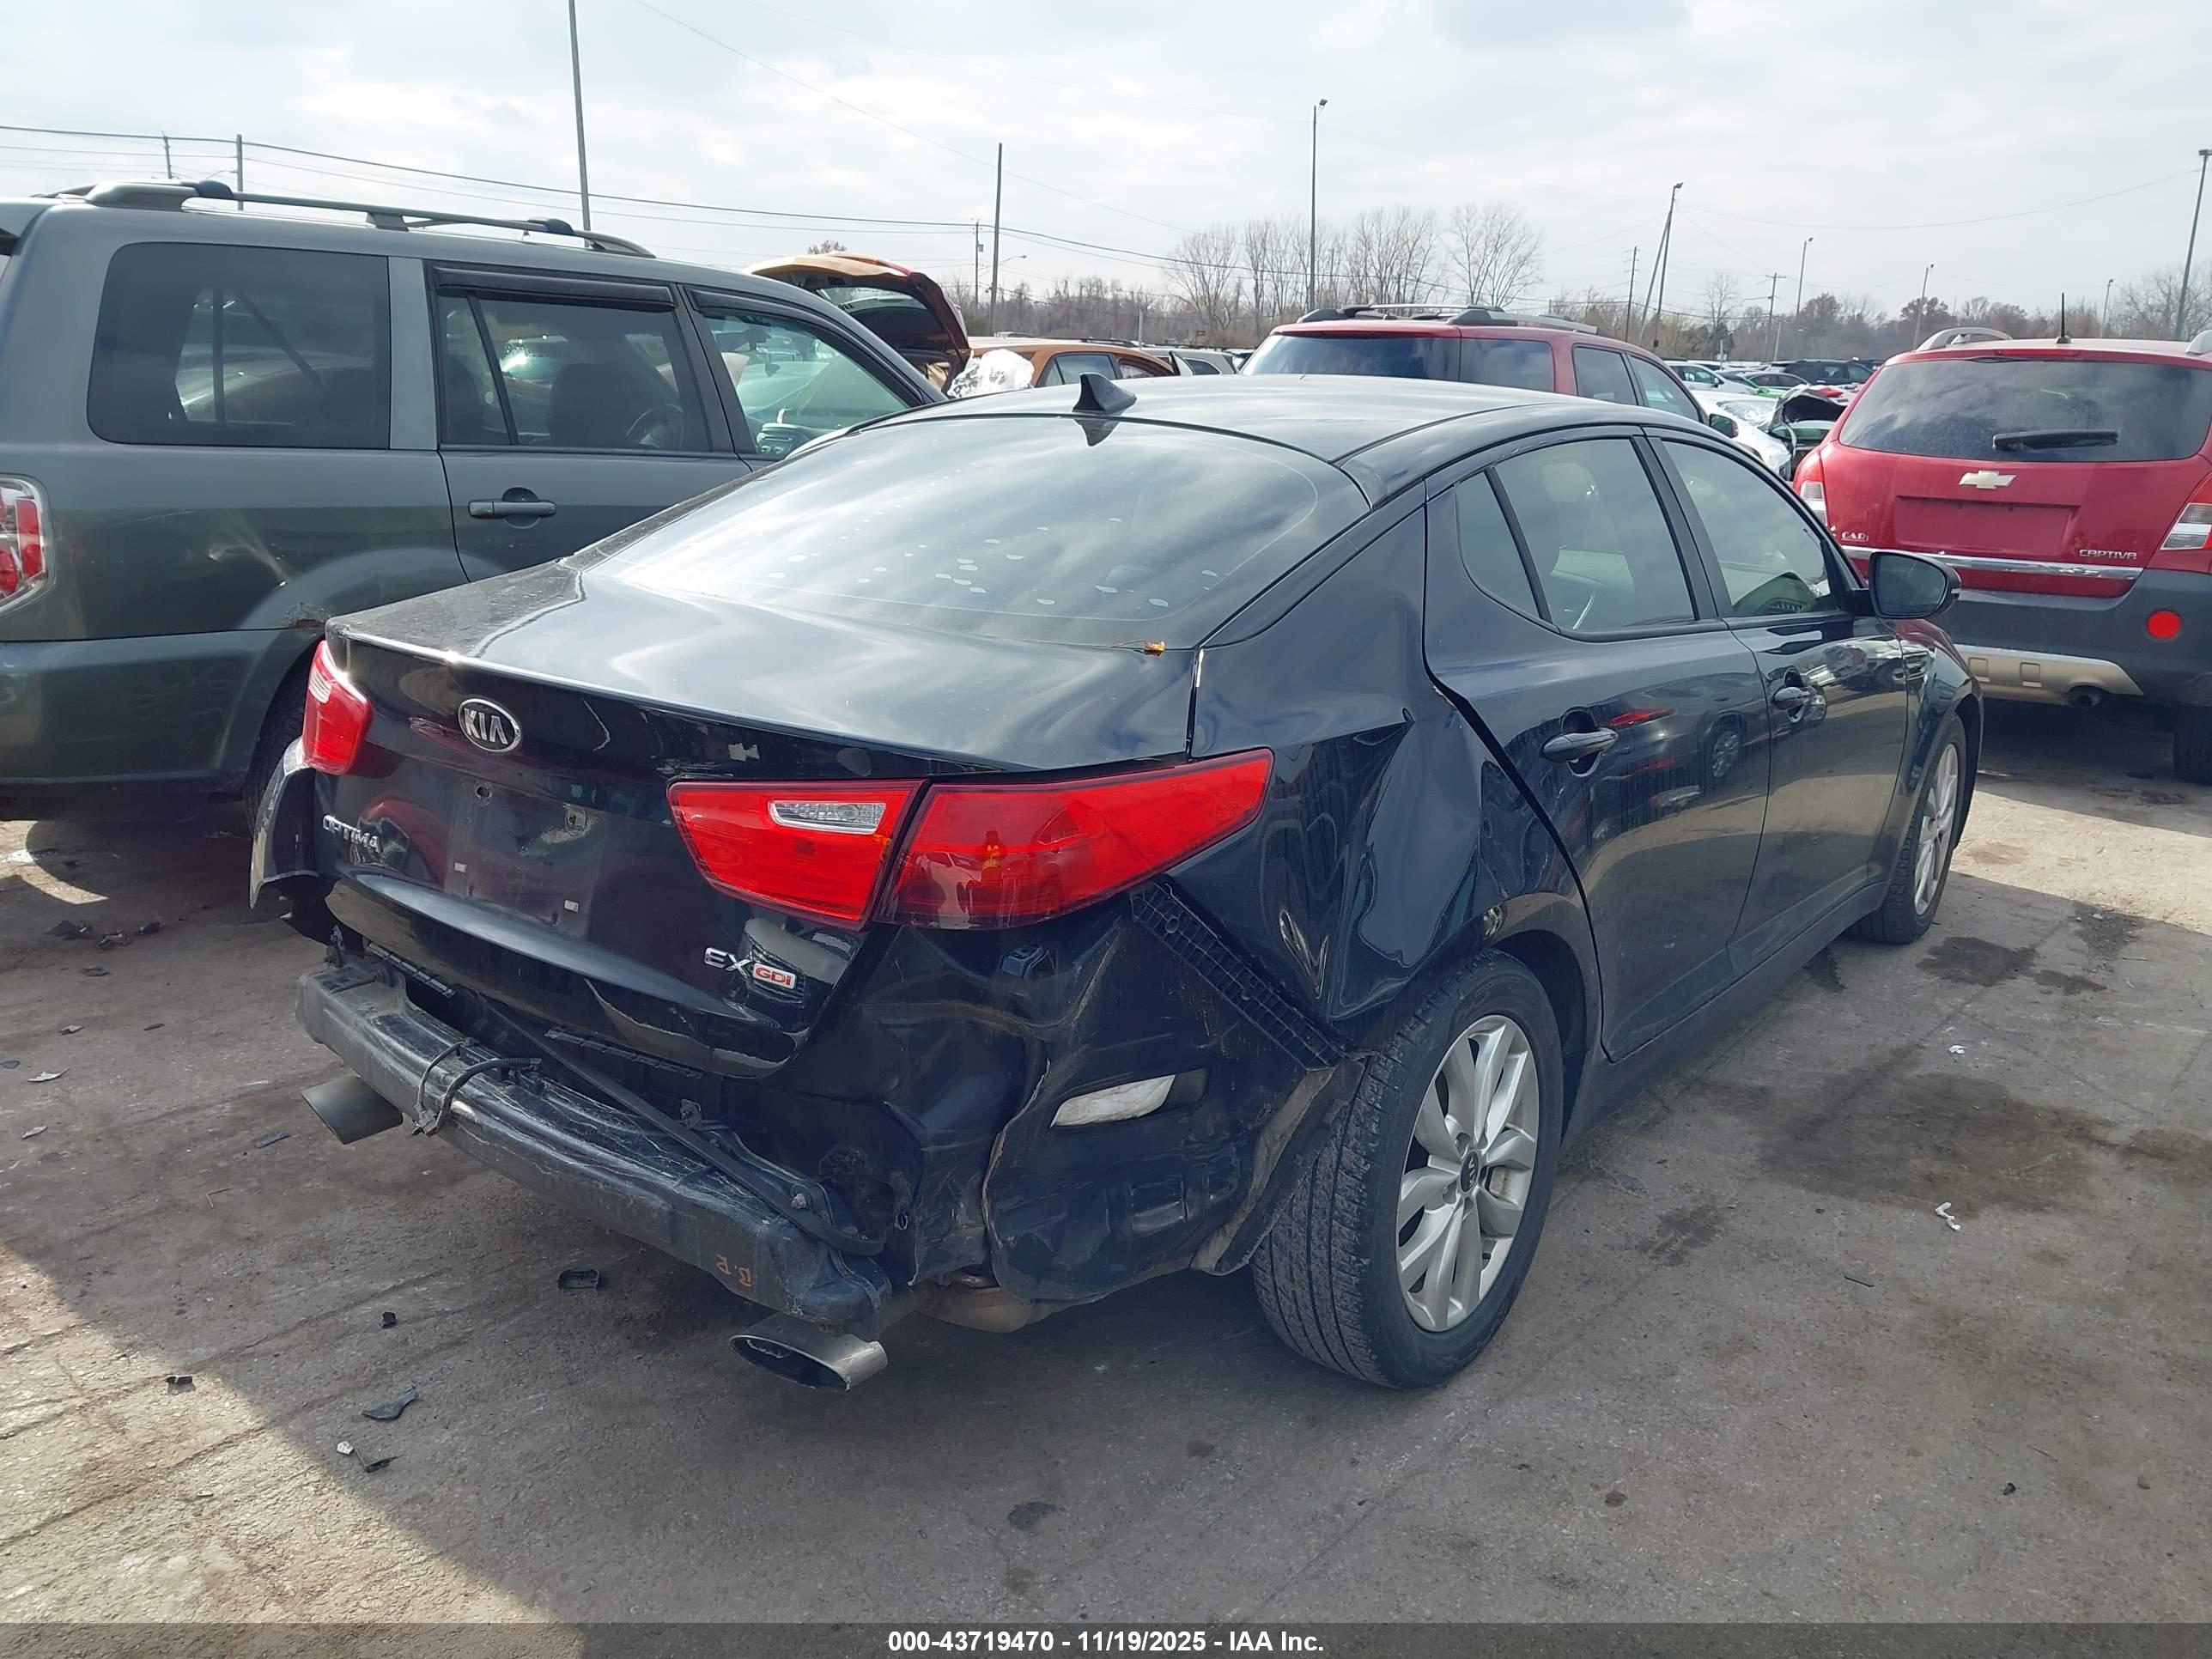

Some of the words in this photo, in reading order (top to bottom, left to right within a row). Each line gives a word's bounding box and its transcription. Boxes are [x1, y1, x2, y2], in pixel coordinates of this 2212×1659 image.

[2079, 549, 2137, 560] CAPTIVA
[464, 708, 508, 745] KIA
[323, 814, 380, 854] OPTIMA
[704, 947, 753, 978] EX
[755, 967, 793, 986] GDI
